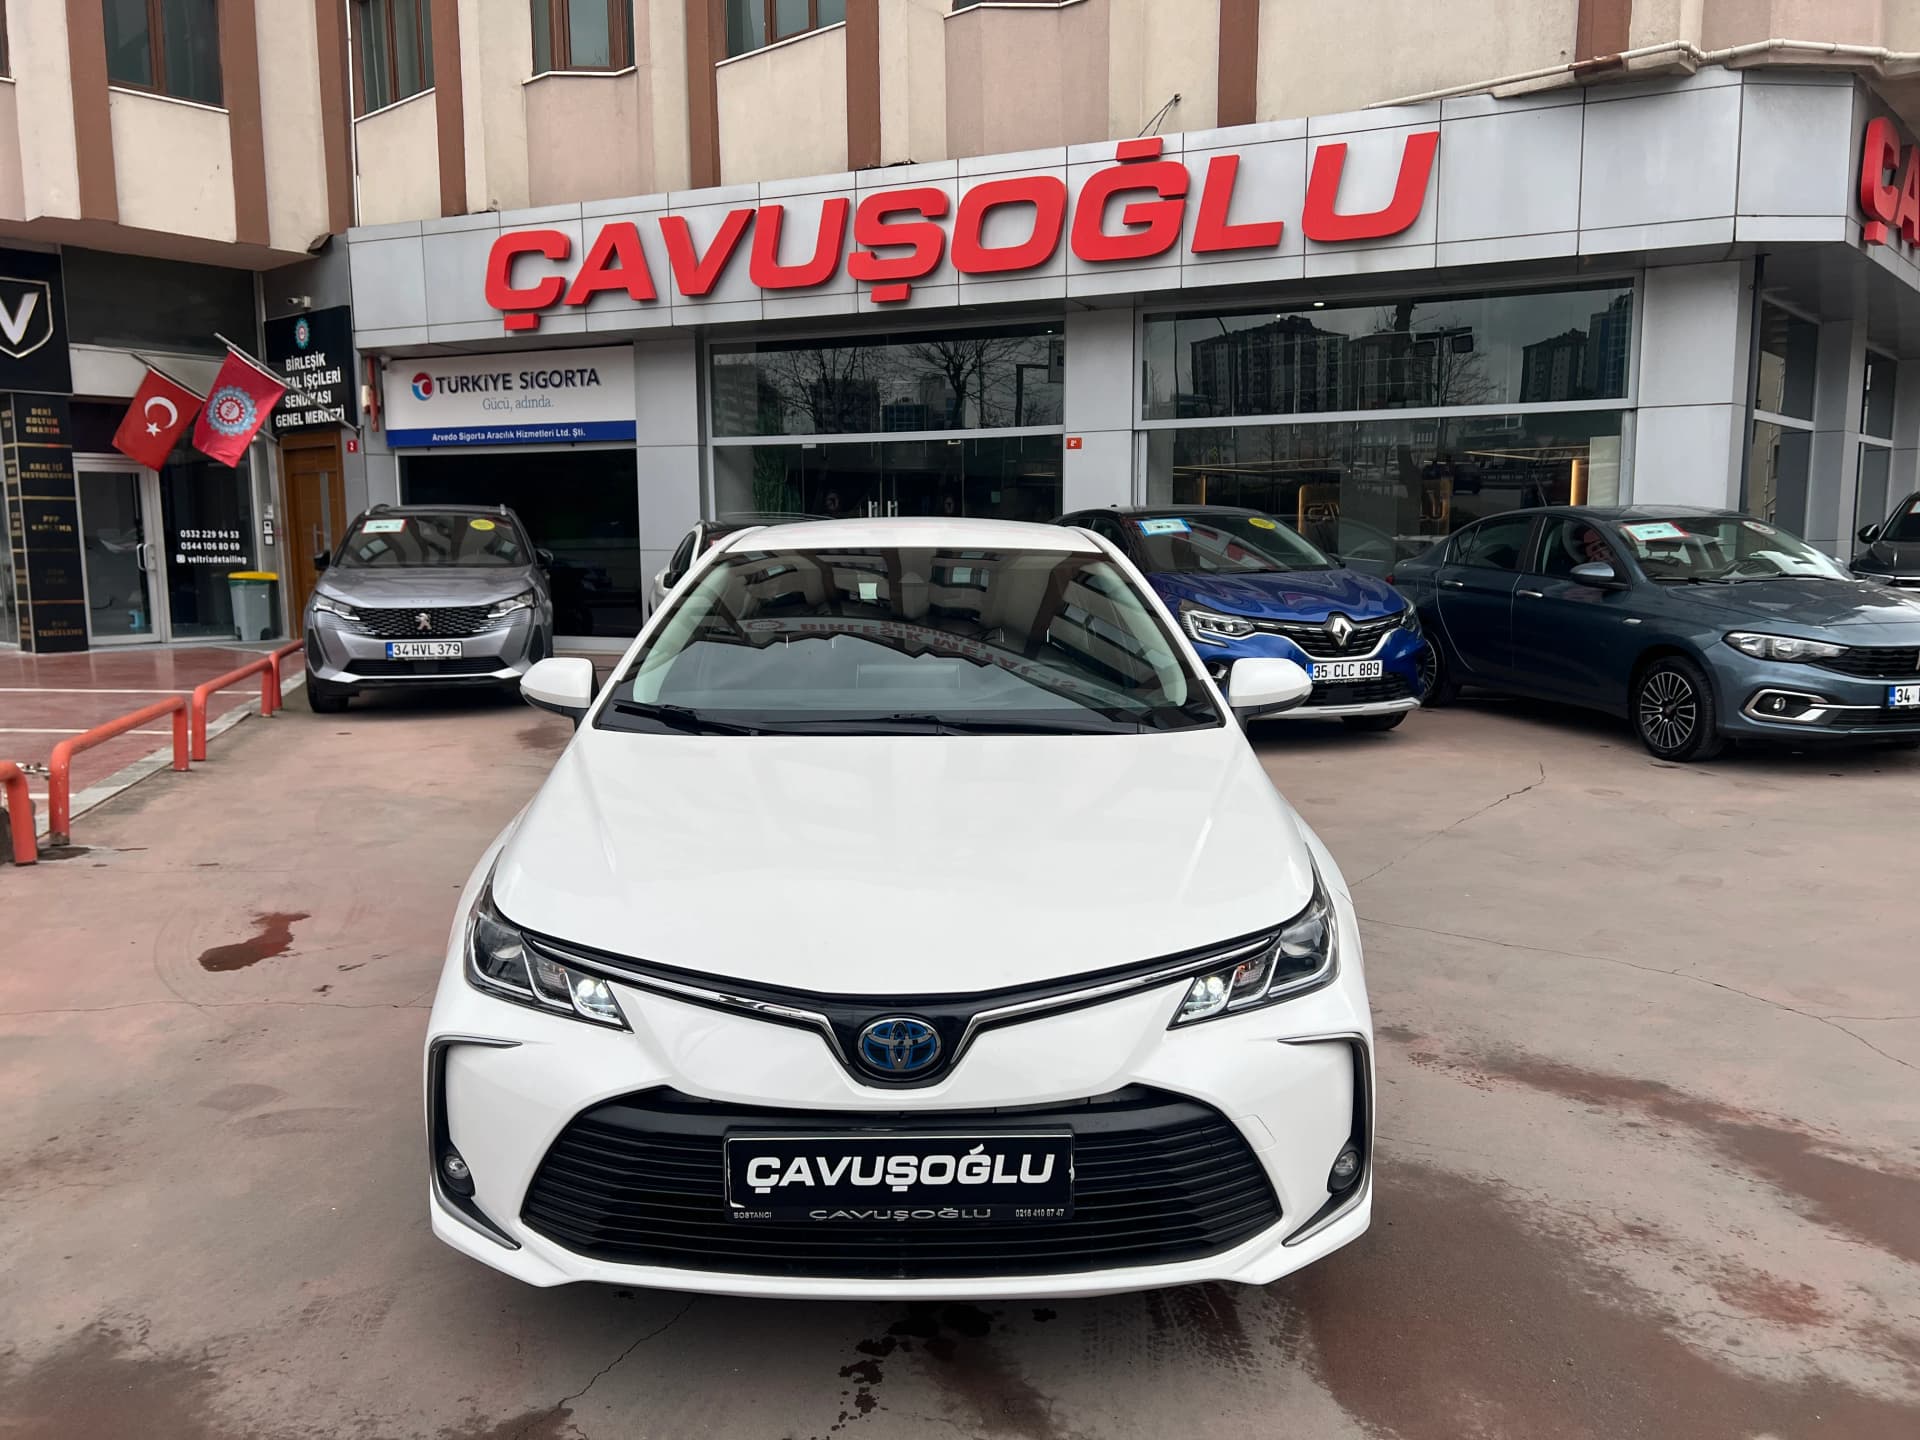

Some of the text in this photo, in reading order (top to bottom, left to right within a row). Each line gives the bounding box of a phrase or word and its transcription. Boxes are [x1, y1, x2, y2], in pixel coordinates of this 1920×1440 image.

[486, 131, 1439, 330] ÇAVUŞOĞLU
[285, 350, 326, 371] BİRLEŞİK
[303, 366, 341, 390] İŞÇİLERİ
[436, 368, 601, 394] TÜRKİYE SİGORTA
[482, 395, 554, 411] Gücü, adında.
[275, 404, 345, 428] GENEL MERKEZİ
[459, 432, 485, 442] Sigorta
[487, 431, 514, 440] Aracılık
[516, 430, 554, 439] Hizmetleri
[555, 429, 571, 437] Ltd.
[181, 542, 202, 550] 0544
[203, 542, 217, 550] 106
[394, 643, 460, 656] 34 HVL 379
[1314, 664, 1328, 678] 35
[1334, 663, 1354, 677] CLC
[1896, 688, 1910, 703] 34
[746, 1143, 1055, 1193] ÇAVUŞOĞLU
[809, 1208, 991, 1221] ÇAVUŞOĞLU
